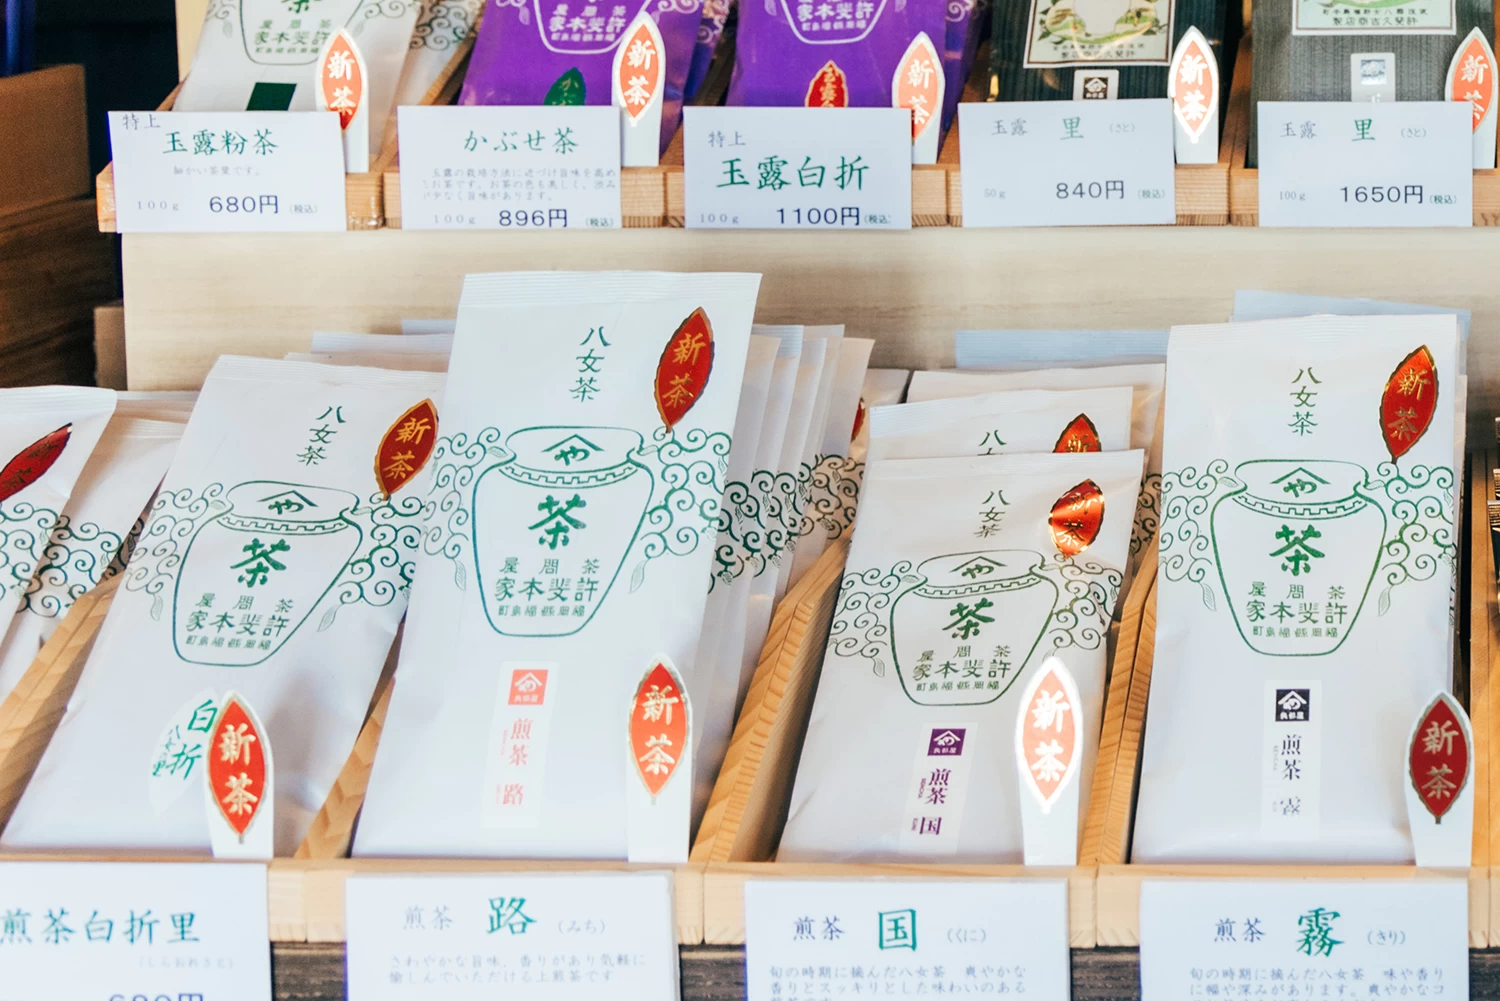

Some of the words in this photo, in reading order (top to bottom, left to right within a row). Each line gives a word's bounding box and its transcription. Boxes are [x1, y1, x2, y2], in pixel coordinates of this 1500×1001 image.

[326, 50, 357, 117] 新茶
[623, 38, 656, 106] 新茶
[907, 58, 935, 126] 新茶
[1179, 53, 1208, 122] 新茶
[1460, 53, 1490, 121] 新茶
[122, 113, 161, 130] 特上
[162, 128, 279, 156] 玉露粉茶
[464, 127, 579, 155] かぶせ茶
[708, 129, 747, 148] 特上
[991, 118, 1029, 138] 玉露
[1059, 115, 1085, 140] 里
[1280, 120, 1318, 139] 玉露
[1350, 118, 1377, 142] 里
[715, 154, 871, 193] 玉露白折
[1055, 180, 1126, 200] 840円
[1339, 185, 1424, 205] 1650円
[209, 195, 279, 214] 680円
[498, 208, 569, 228] 896円
[776, 206, 861, 226] 1100円
[569, 325, 612, 403] 八女茶
[662, 332, 707, 409] 新茶
[1286, 366, 1323, 437] 八女茶
[1386, 366, 1431, 441] 新茶
[296, 404, 347, 466] 八女茶
[382, 416, 432, 481] 新茶
[528, 493, 588, 551] 茶
[973, 488, 1012, 539] 八女茶
[1056, 490, 1098, 548] 新茶
[229, 537, 292, 589] 茶
[1268, 523, 1326, 577] 茶
[941, 597, 996, 641] 茶
[170, 698, 218, 780] 白折
[508, 717, 534, 767] 煎茶
[638, 684, 680, 776] 新茶
[1030, 689, 1071, 782] 新茶
[218, 722, 259, 817] 新茶
[1281, 733, 1303, 781] 煎茶
[1421, 720, 1460, 801] 新茶
[502, 783, 525, 807] 路
[924, 767, 952, 805] 煎茶
[919, 816, 942, 836] 国
[0, 906, 201, 945] 煎茶白折里
[402, 904, 454, 931] 煎茶
[486, 896, 538, 936] 路
[793, 915, 845, 942] 煎茶
[878, 908, 918, 952] 国
[1213, 917, 1266, 943] 煎茶
[1295, 907, 1346, 957] 霧
